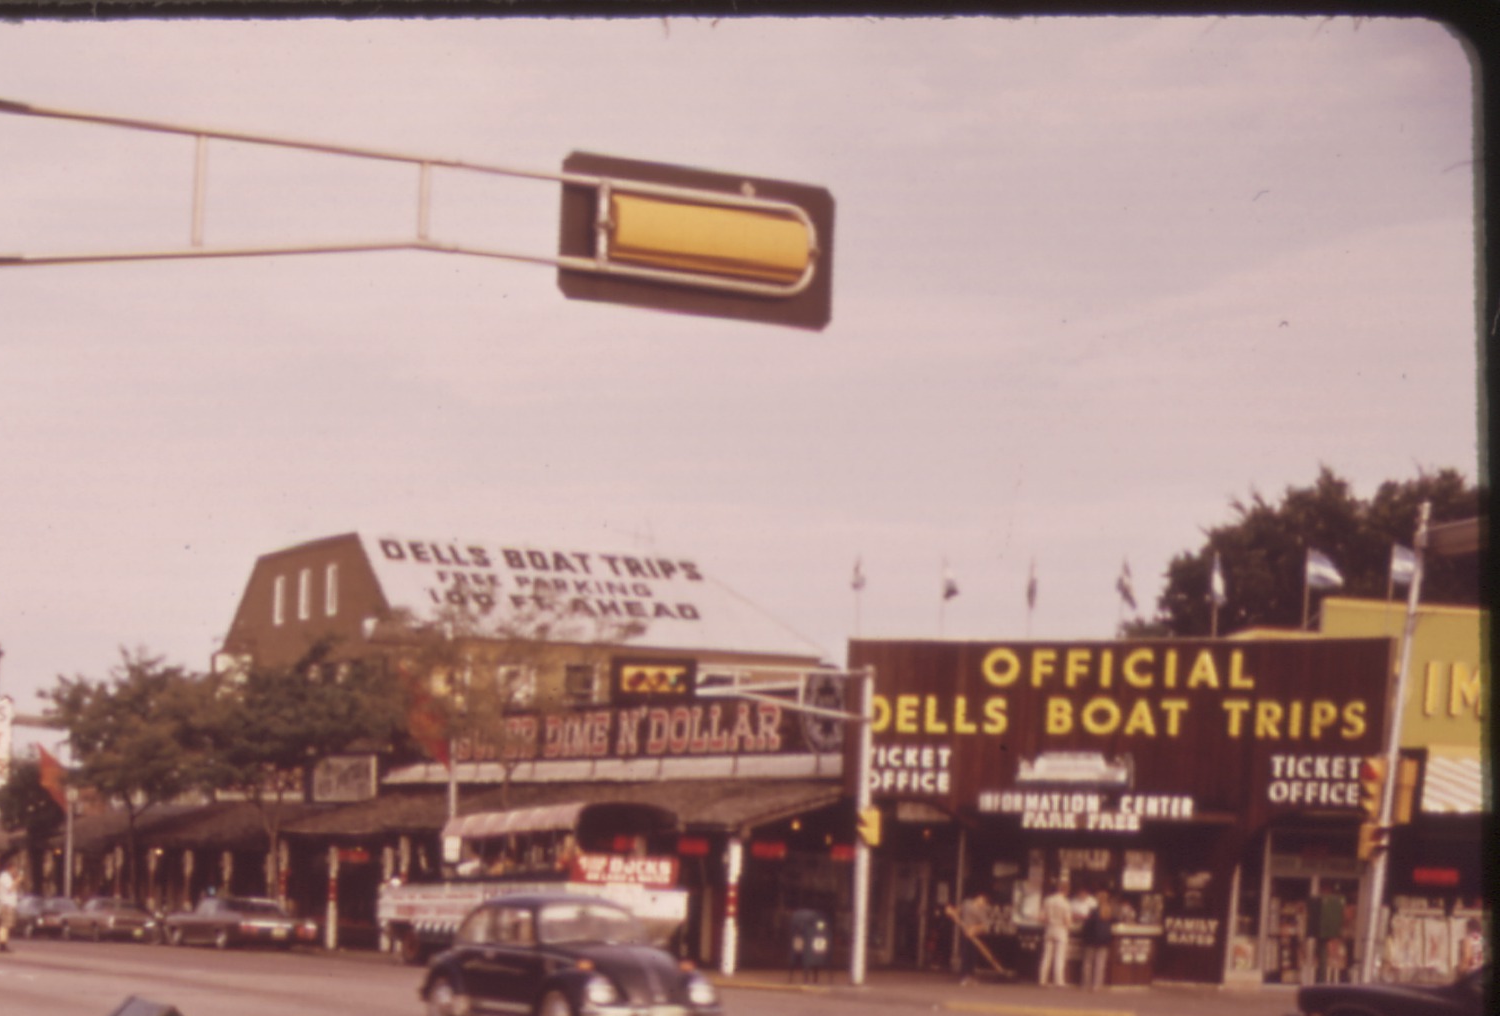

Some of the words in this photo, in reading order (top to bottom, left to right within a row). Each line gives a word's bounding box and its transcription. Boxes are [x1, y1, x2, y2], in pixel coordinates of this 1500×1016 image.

[378, 539, 491, 567] DELLS
[501, 548, 593, 574] BOAT
[600, 553, 704, 581] TRIPS
[436, 570, 501, 588] FREE
[514, 575, 653, 598] PARKING
[570, 597, 701, 621] AHEAD
[982, 648, 1254, 688] OFFICIAL
[871, 694, 1008, 733] DELLS
[1047, 697, 1188, 735] BOAT
[1223, 700, 1366, 739] TRIPS
[543, 711, 611, 758] DIME
[1271, 755, 1361, 779] TICKET
[978, 792, 1100, 813] INFORMATION
[1120, 794, 1194, 818] CENTER
[1268, 781, 1360, 805] OFFICE
[1164, 917, 1219, 933] FAMILY
[1166, 931, 1215, 947] RATES
